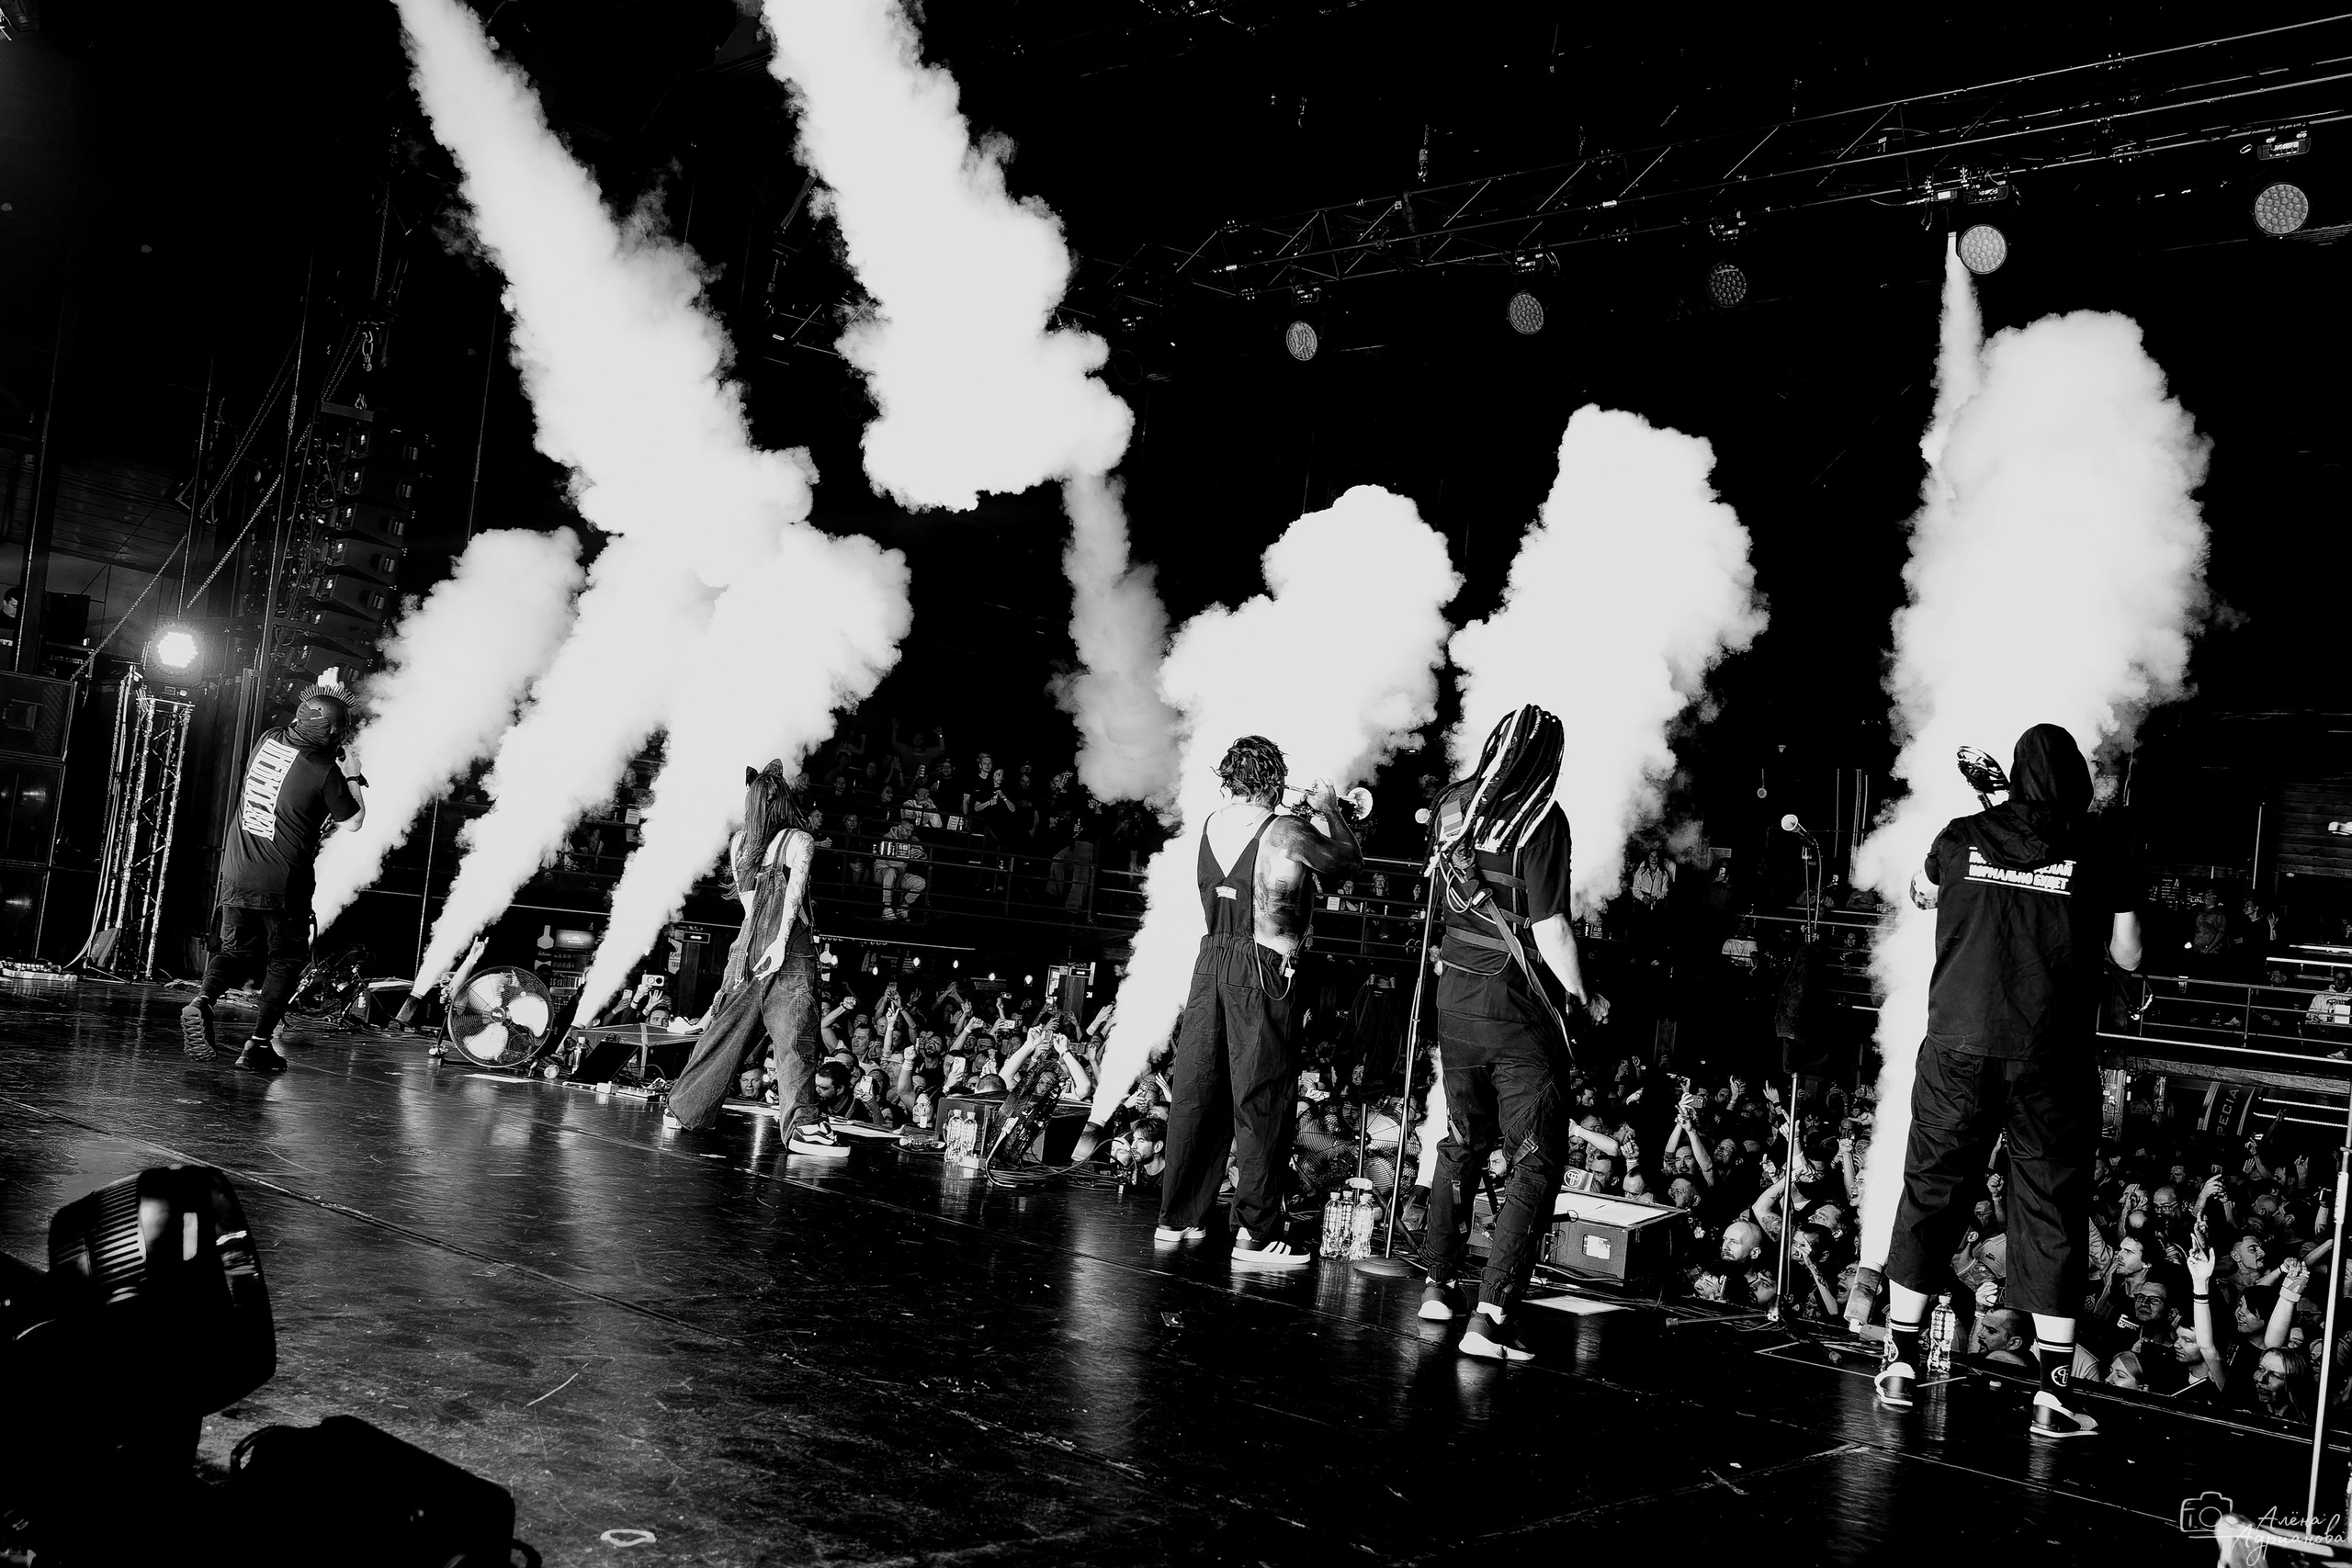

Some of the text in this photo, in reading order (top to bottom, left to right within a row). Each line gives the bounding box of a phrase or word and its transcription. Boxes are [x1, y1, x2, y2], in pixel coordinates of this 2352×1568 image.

[1969, 864, 2069, 890] НОРМАЛЬНО БУДЕТ
[2033, 862, 2073, 877] ЕЛАЙ
